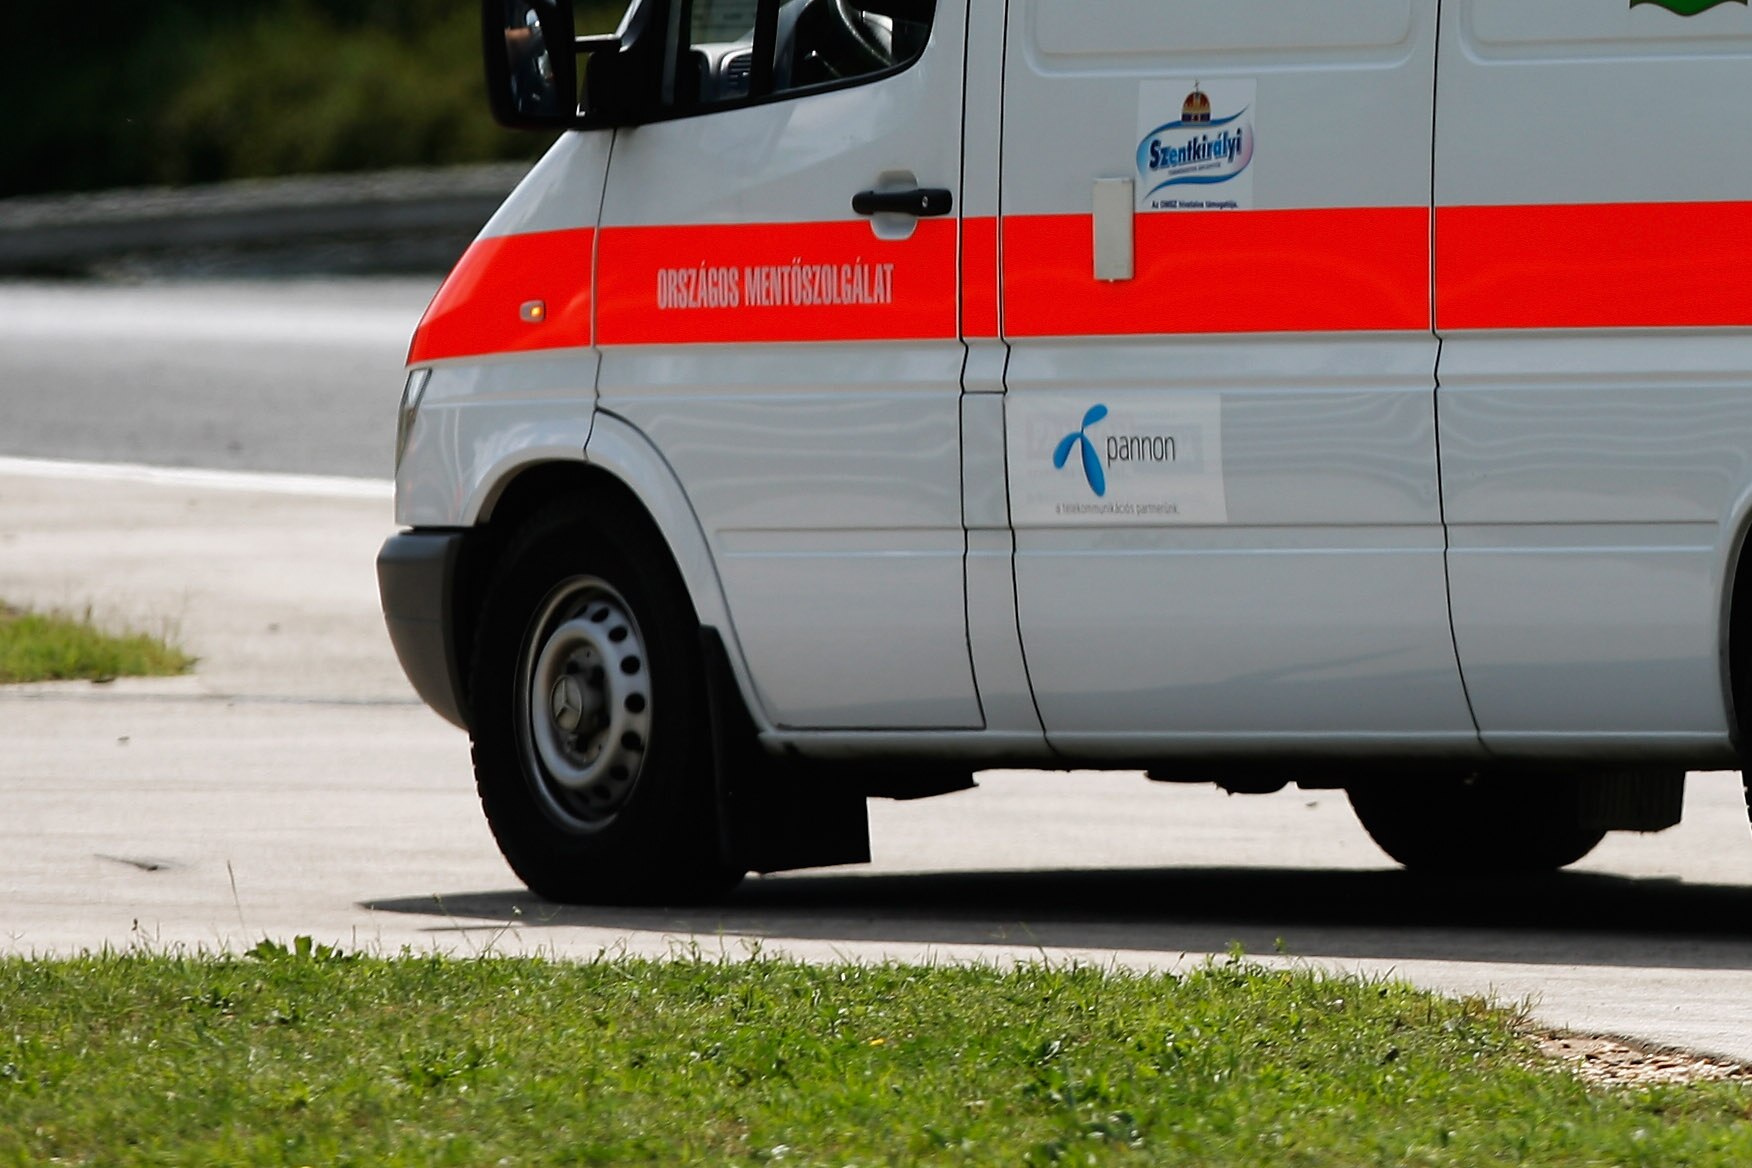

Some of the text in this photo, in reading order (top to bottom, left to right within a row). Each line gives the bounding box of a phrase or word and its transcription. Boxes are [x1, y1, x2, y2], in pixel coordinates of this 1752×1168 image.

[1148, 127, 1243, 171] Szentkirályi
[657, 255, 895, 310] ORSZÁGOS MENTŐSZOLGÁLAT
[1106, 435, 1177, 470] pannon
